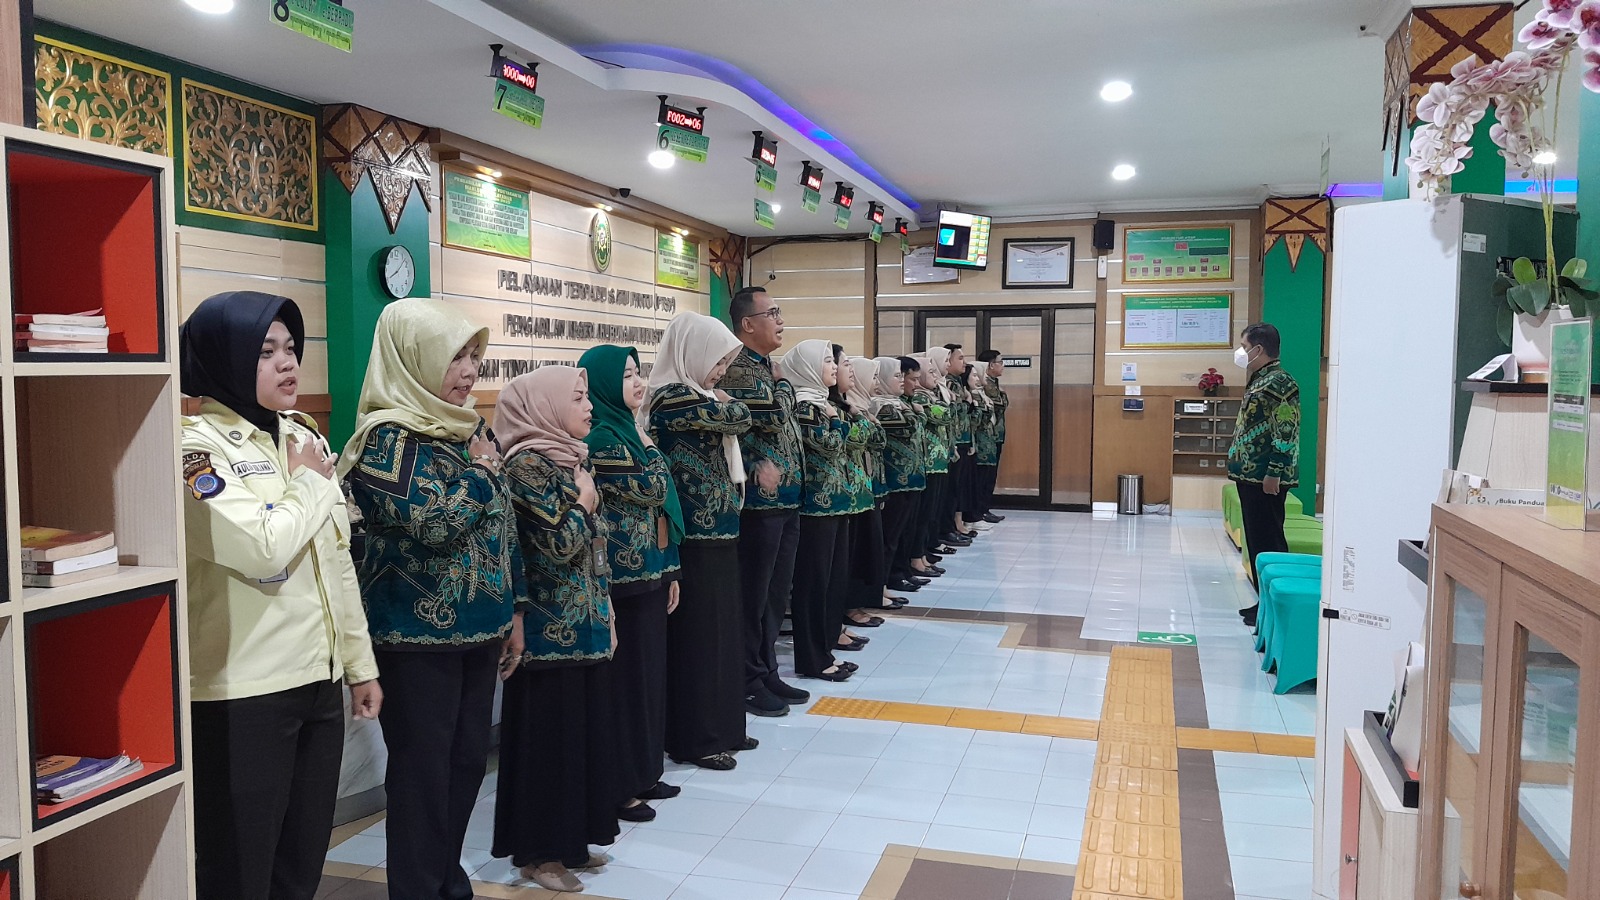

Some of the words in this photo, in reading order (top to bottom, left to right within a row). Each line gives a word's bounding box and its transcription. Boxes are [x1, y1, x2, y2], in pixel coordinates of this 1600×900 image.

[496, 83, 508, 110] 7
[667, 110, 686, 126] F002
[692, 118, 702, 130] 06
[659, 129, 670, 151] 6
[755, 202, 761, 221] 5
[497, 269, 562, 298] PELAYANAN
[564, 281, 607, 304] TERPADU
[630, 291, 654, 310] PINTU
[503, 313, 565, 340] PENGADILAN
[478, 358, 500, 380] DAN
[182, 453, 206, 463] OLDA
